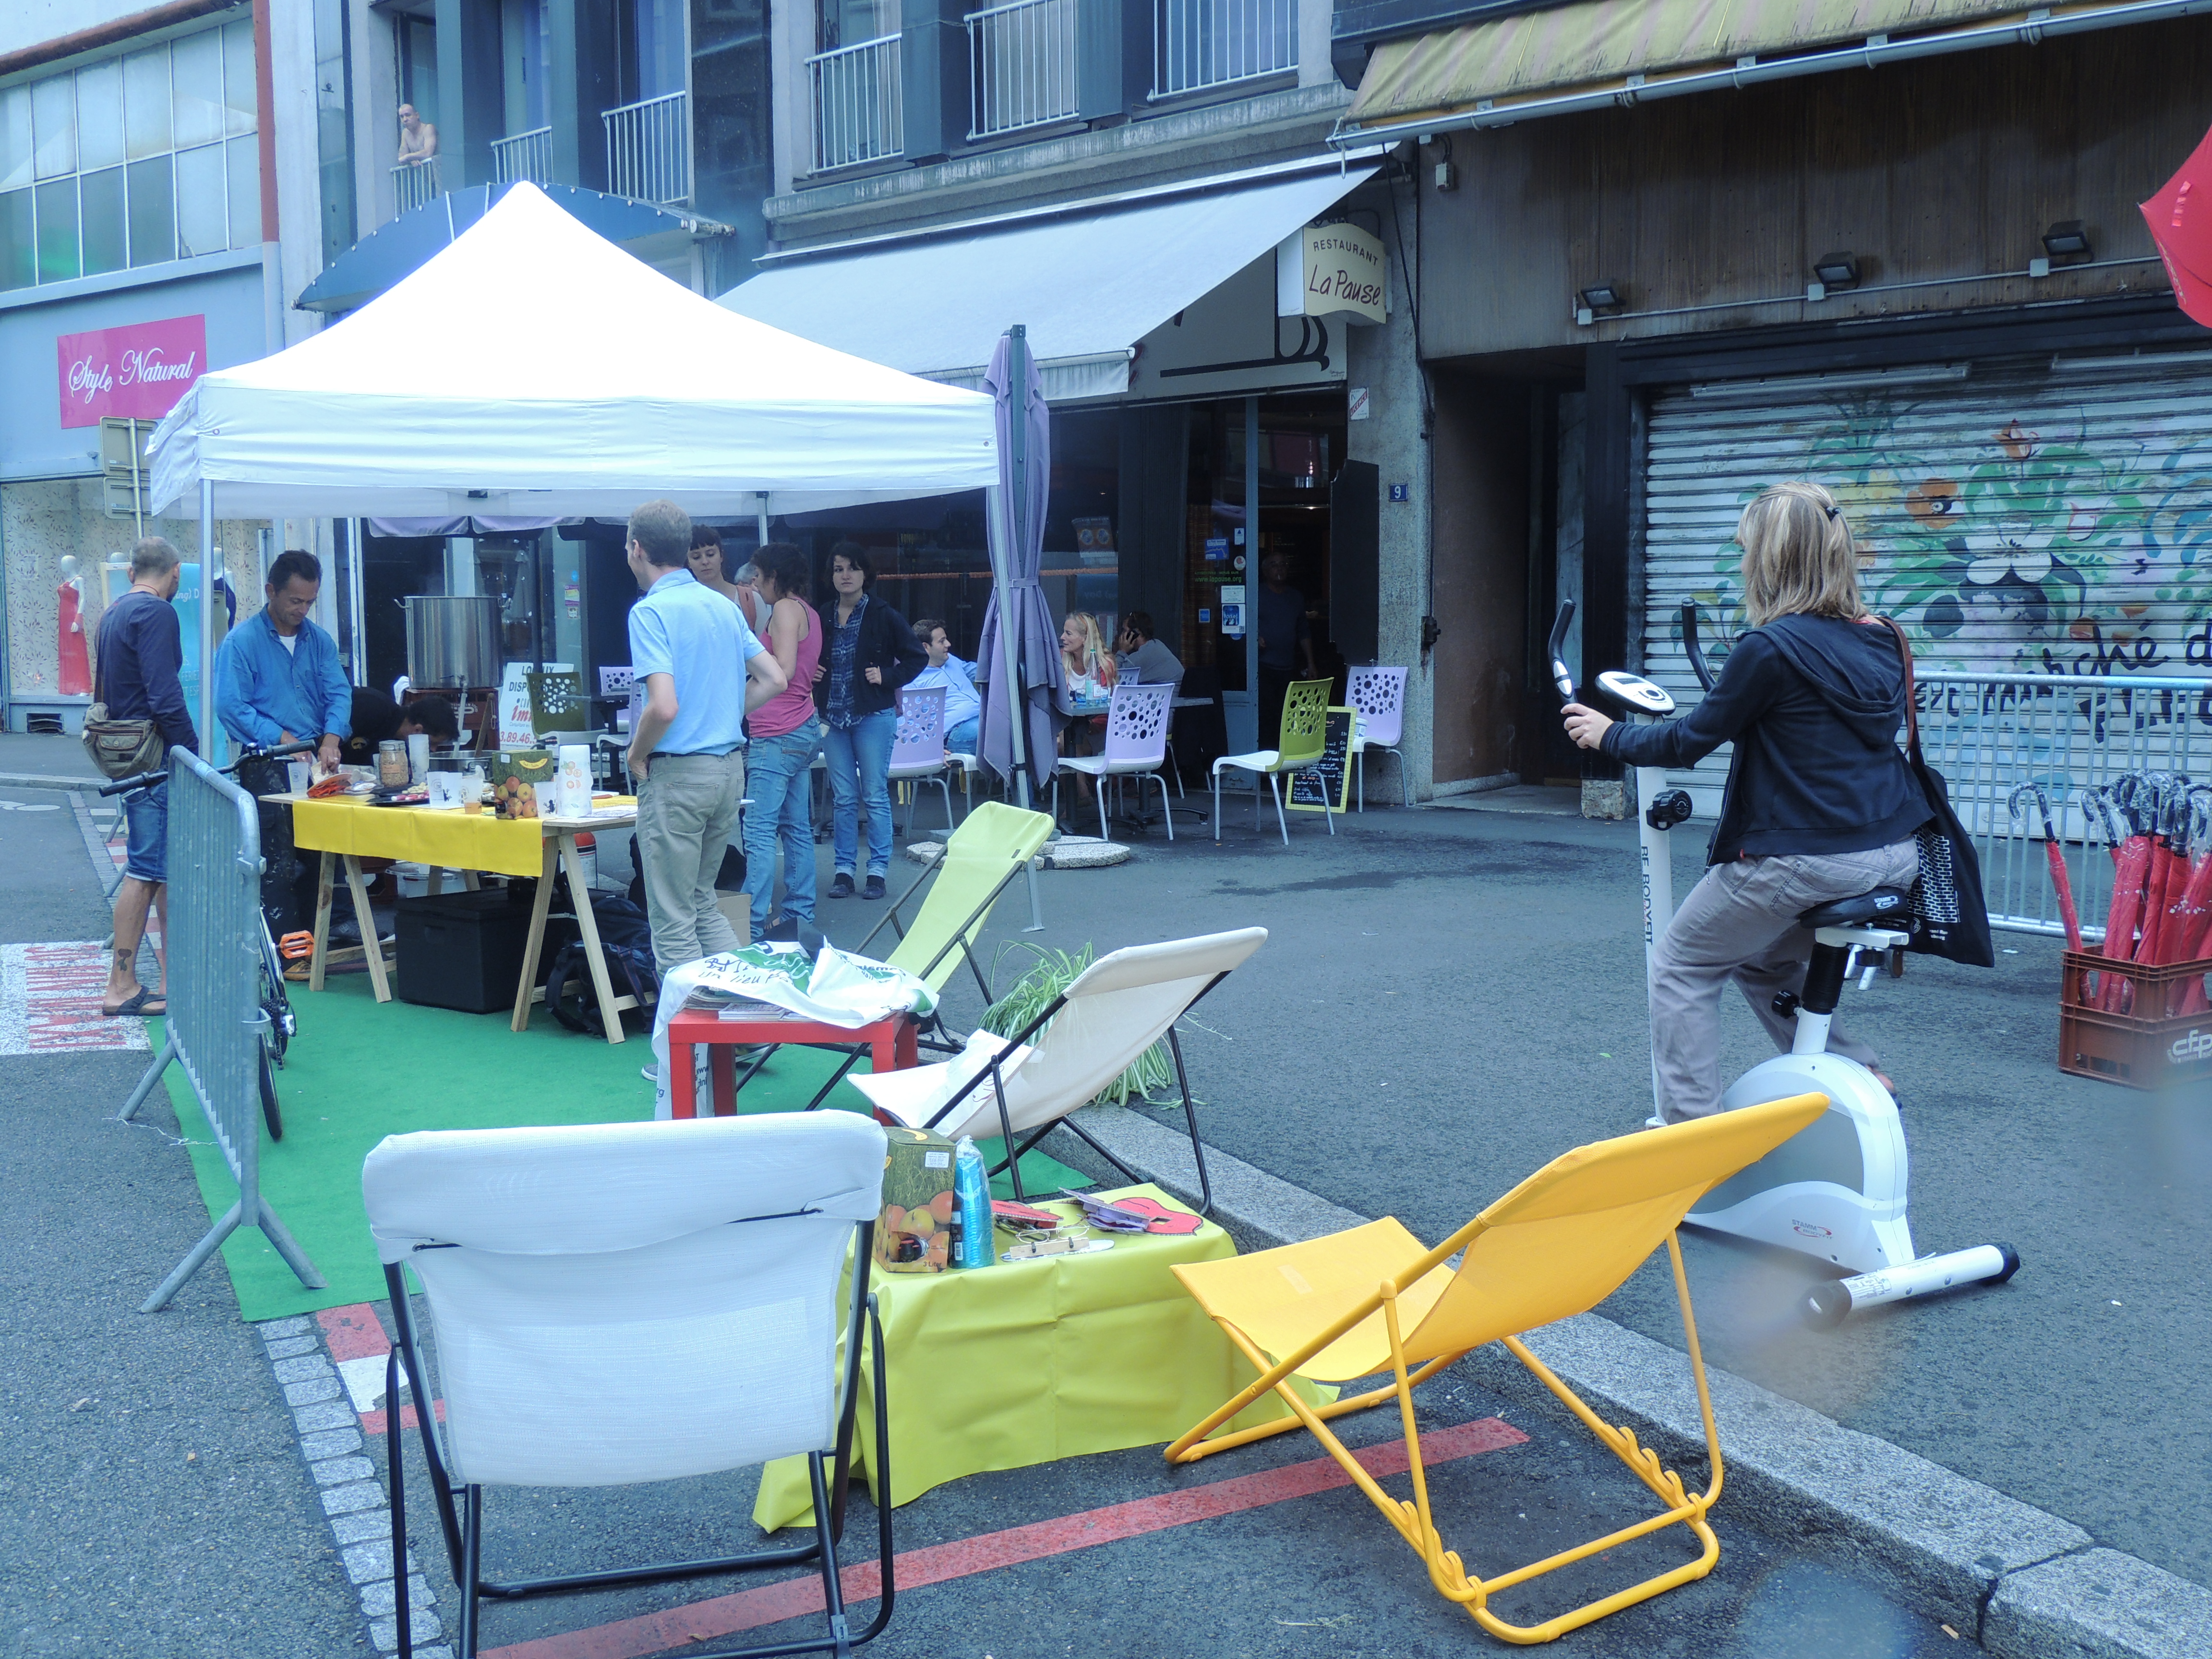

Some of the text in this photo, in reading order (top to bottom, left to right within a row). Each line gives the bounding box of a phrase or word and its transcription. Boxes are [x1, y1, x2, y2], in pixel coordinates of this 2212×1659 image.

[1313, 239, 1378, 266] RESTAURANT
[1309, 264, 1381, 306] La Pause
[68, 347, 196, 404] Style Natural
[1394, 485, 1401, 499] 9
[1791, 1219, 1817, 1231] STAMM
